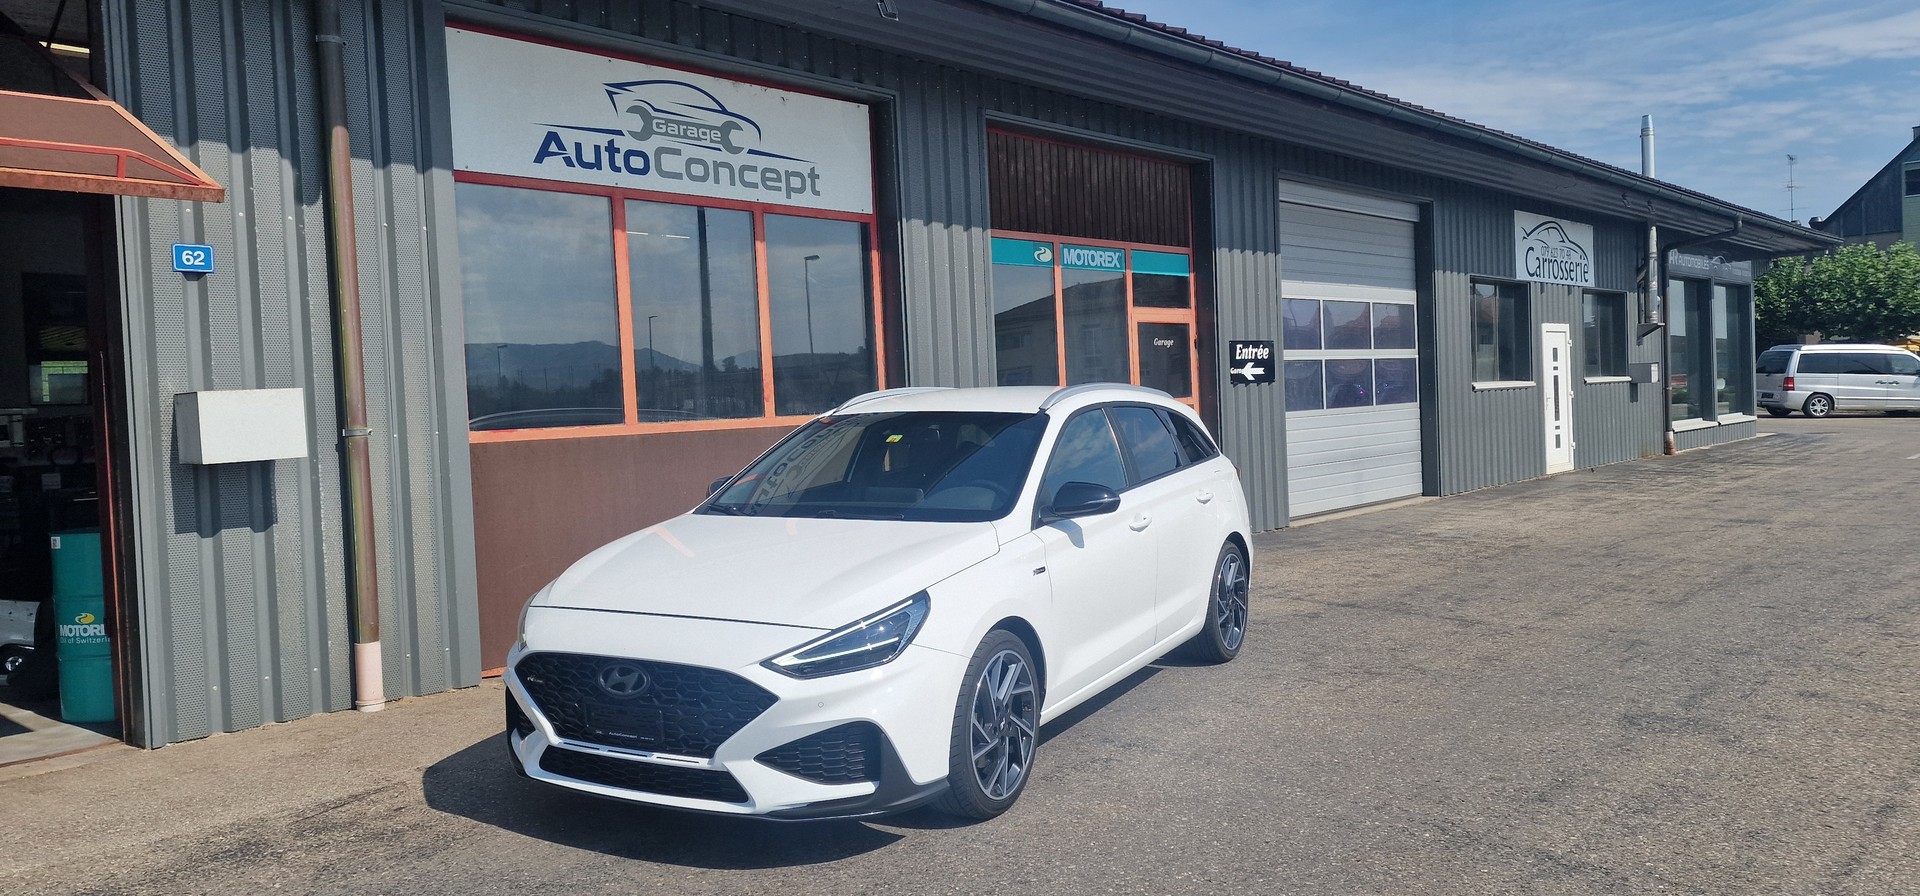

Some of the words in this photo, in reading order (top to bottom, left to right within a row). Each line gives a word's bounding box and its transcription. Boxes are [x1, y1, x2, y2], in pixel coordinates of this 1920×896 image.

[652, 118, 722, 142] Garage
[533, 130, 821, 199] AutoConcept
[181, 250, 206, 266] 62
[1063, 247, 1120, 268] MOTOREX
[1525, 246, 1589, 283] Carrosserie
[1153, 337, 1174, 349] Garage
[1235, 343, 1270, 360] Entrée
